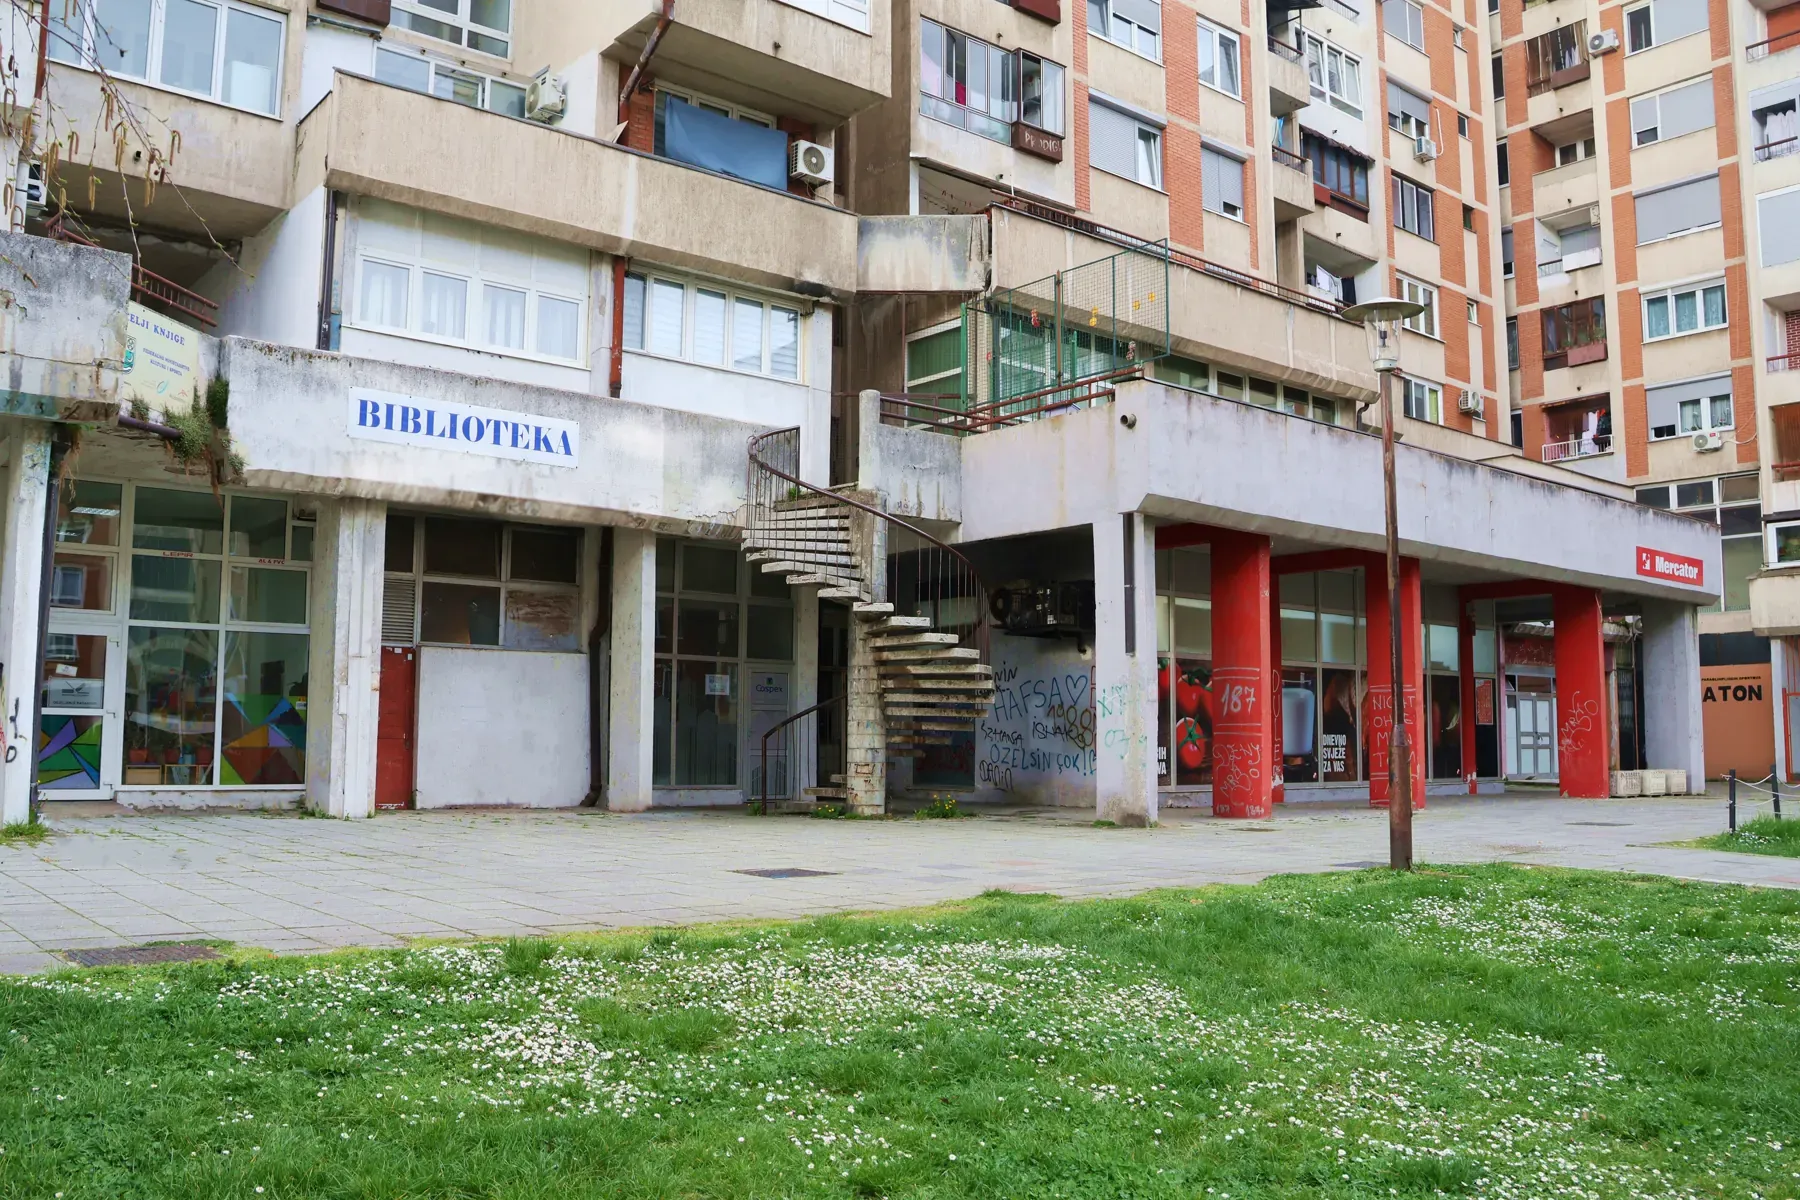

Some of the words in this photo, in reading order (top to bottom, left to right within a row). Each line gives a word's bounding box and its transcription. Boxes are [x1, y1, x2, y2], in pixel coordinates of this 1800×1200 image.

[127, 313, 149, 330] ELJI
[153, 324, 186, 346] KNJIGE
[357, 398, 573, 457] BIBLIOTEKA
[1655, 555, 1699, 580] Mercator
[755, 684, 783, 694] Cospex
[993, 676, 1064, 722] HAFSA
[1220, 683, 1256, 717] 187
[1702, 684, 1763, 703] ATON
[1323, 734, 1347, 746] DNEVNO
[1323, 760, 1332, 773] ZA
[1333, 760, 1345, 773] VAS
